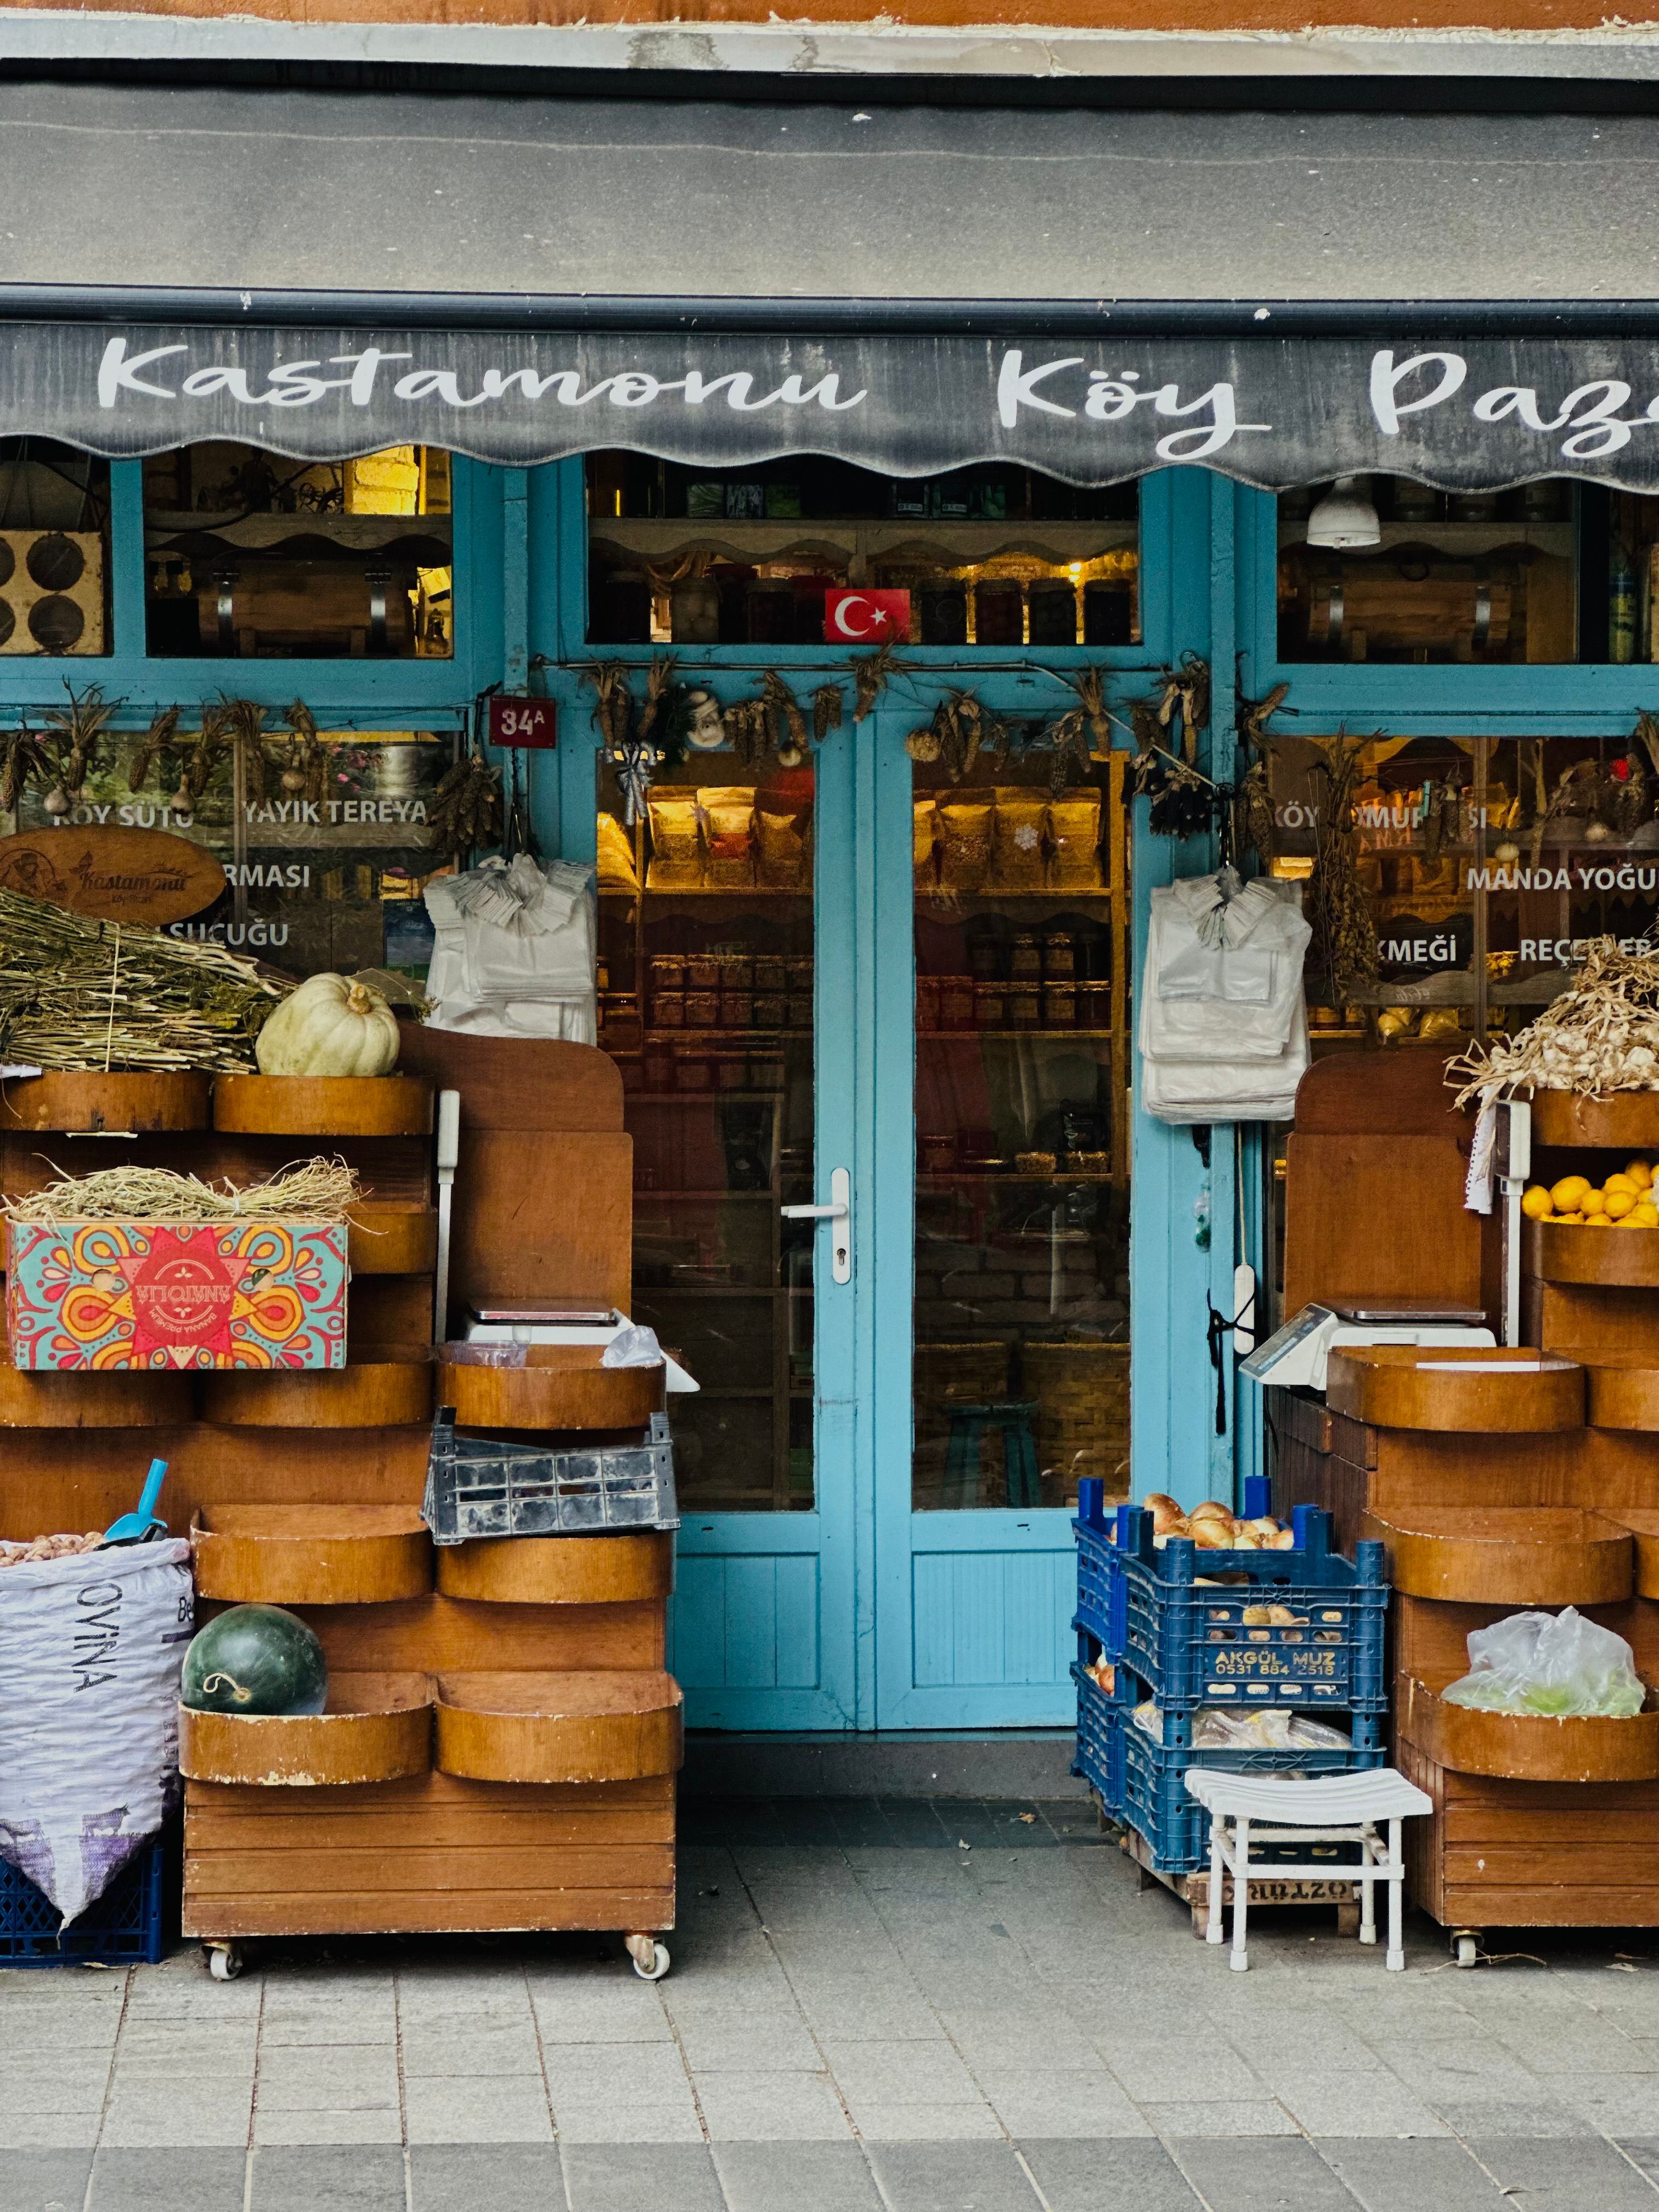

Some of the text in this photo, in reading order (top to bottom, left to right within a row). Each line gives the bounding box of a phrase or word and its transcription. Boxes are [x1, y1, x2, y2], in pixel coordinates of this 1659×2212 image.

[98, 337, 867, 410] Kastamonu
[997, 349, 1272, 460] Köy
[242, 800, 426, 823] YAYIK TEREYA
[222, 864, 309, 887] RMASI
[1467, 863, 1659, 890] MANDA YOĞU
[1377, 934, 1456, 962] KMEĞİ
[136, 1285, 231, 1305] ANATOLIA
[149, 1308, 217, 1333] BANANA PREMIUM
[1215, 1650, 1336, 1666] AKGÜL MUZ
[1216, 1664, 1251, 1674] 0531
[1260, 1664, 1290, 1675] 884
[1223, 1882, 1347, 1900] ÖZTÜR
